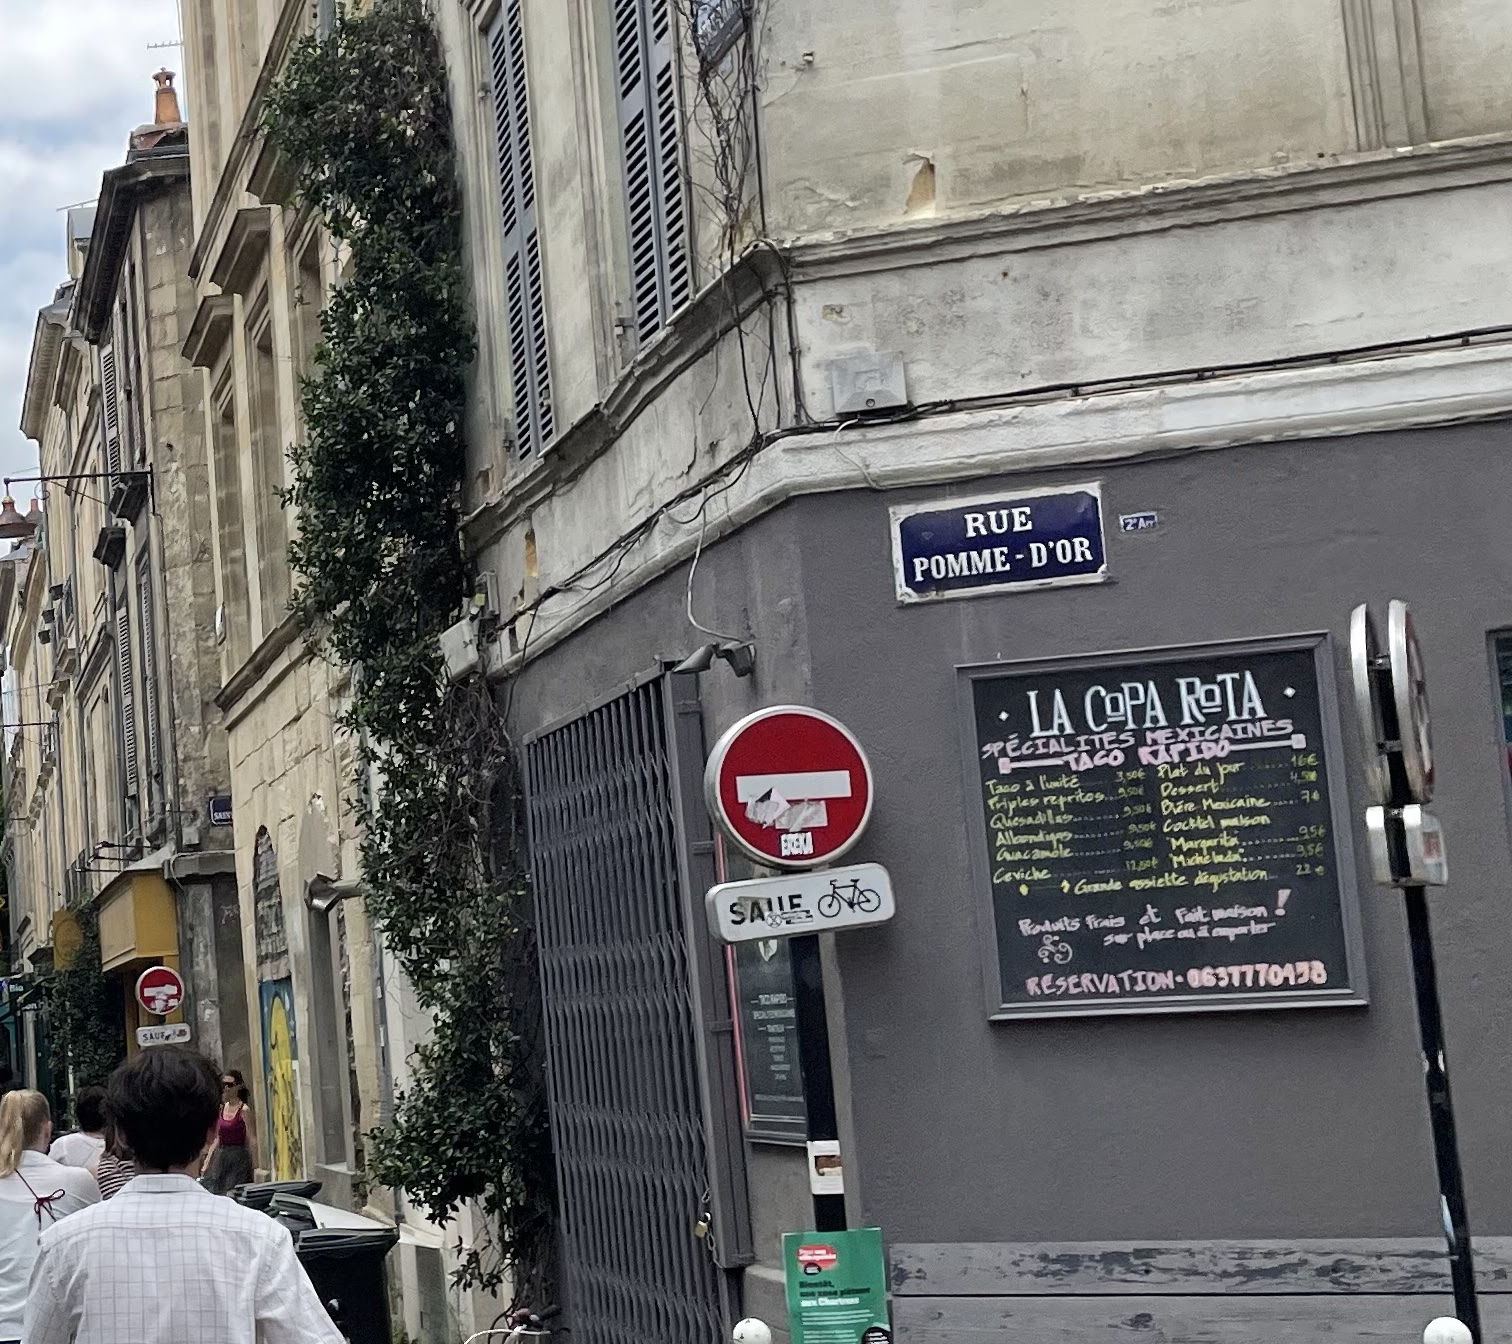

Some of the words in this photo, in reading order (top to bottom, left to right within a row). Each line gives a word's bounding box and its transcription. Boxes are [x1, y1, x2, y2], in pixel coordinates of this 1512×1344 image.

[963, 507, 1033, 538] RUE
[1027, 688, 1075, 738] LA
[1145, 719, 1294, 746] MEXICAINES
[1062, 749, 1126, 771] TACO
[1138, 740, 1232, 766] RAPIDO
[1157, 762, 1188, 778] Plat
[1194, 761, 1211, 775] du
[985, 779, 1020, 795] Taco
[1160, 778, 1219, 797] Dessert
[1202, 794, 1271, 811] Mexicaine
[993, 866, 1052, 885] Ceviche
[1074, 878, 1123, 896] Grande
[1138, 903, 1161, 925] et
[1026, 969, 1175, 997] RESERVATION
